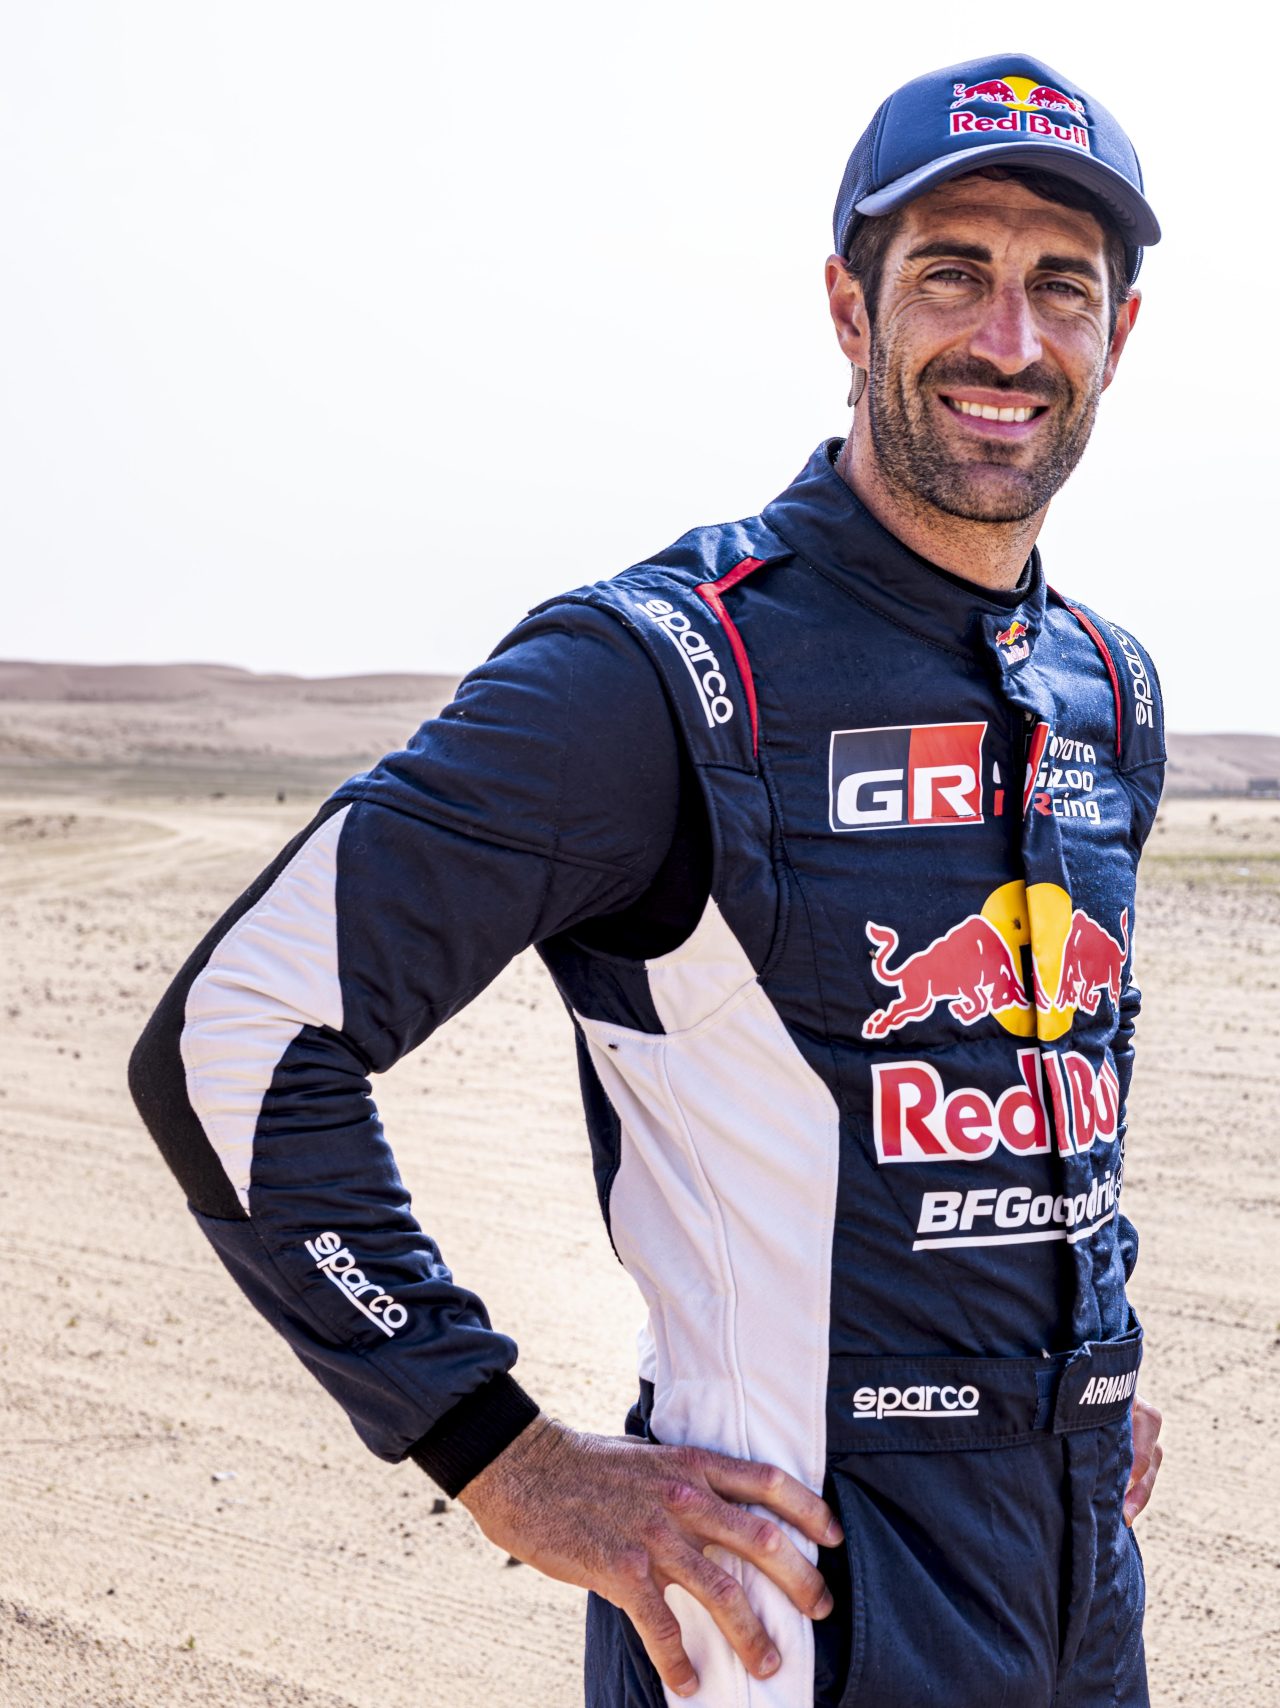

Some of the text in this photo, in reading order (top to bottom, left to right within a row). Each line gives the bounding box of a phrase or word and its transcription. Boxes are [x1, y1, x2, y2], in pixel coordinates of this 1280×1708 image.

[950, 110, 1091, 152] Red Bull
[635, 599, 734, 728] sparco
[837, 764, 979, 825] GR
[871, 1047, 1076, 1165] Red
[304, 1231, 408, 1338] sparco
[853, 1385, 980, 1419] sparco
